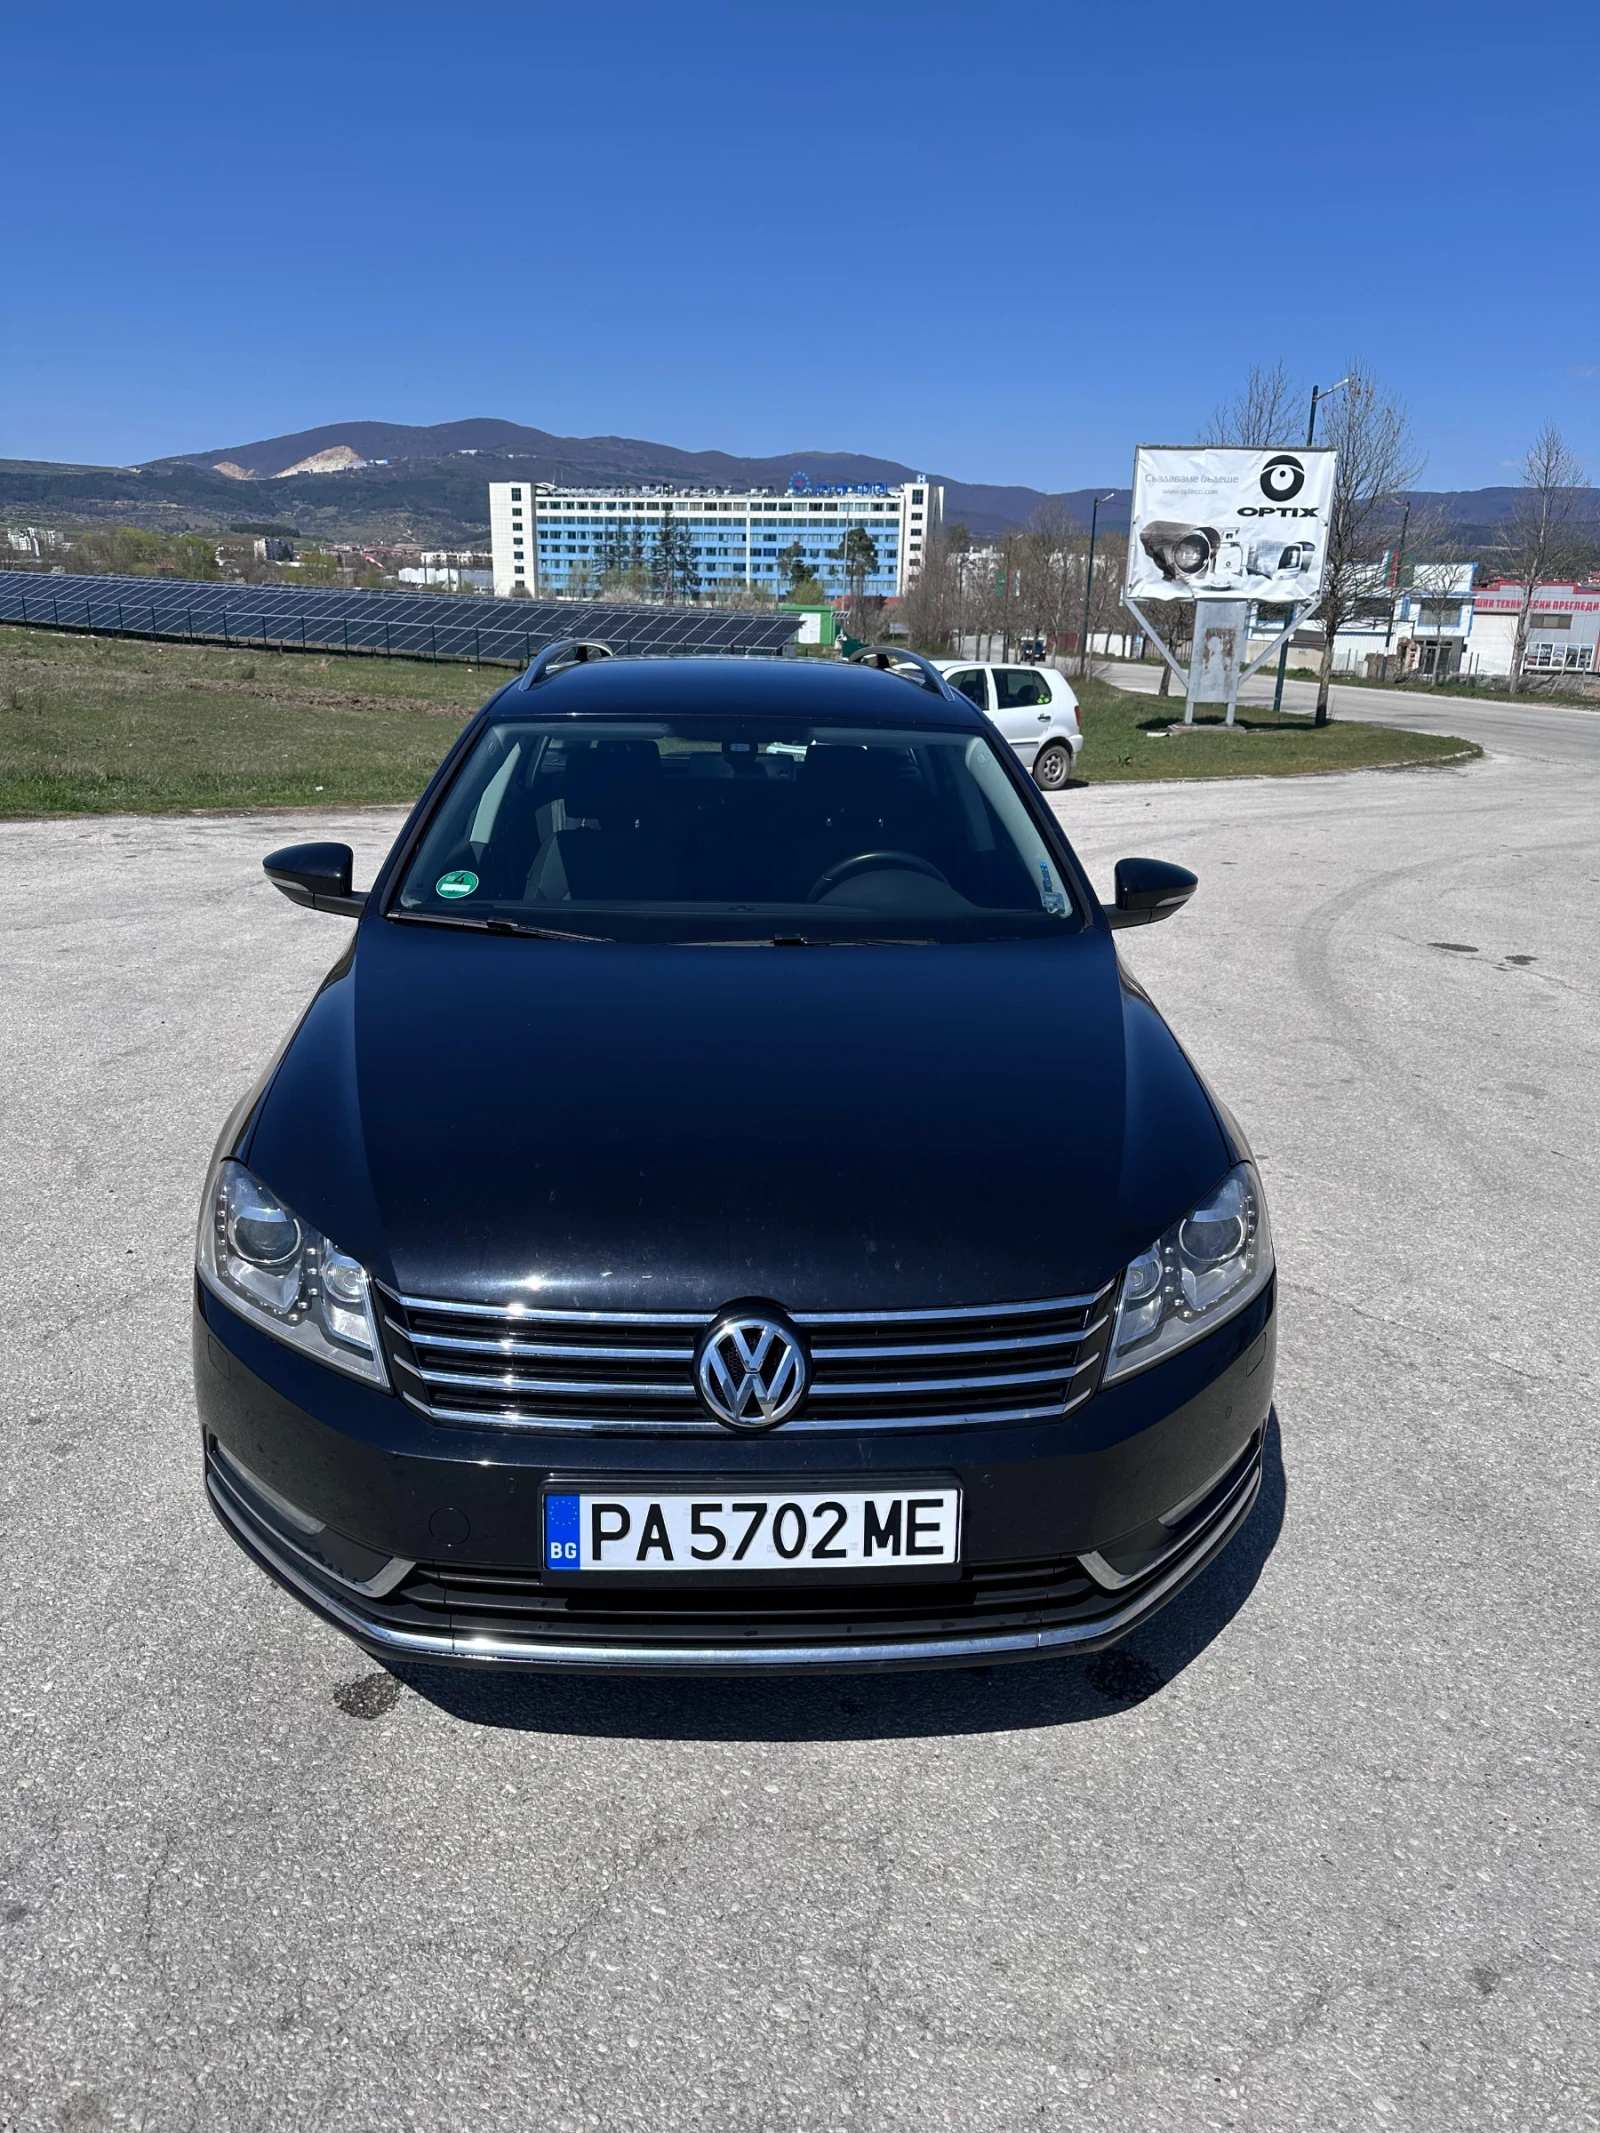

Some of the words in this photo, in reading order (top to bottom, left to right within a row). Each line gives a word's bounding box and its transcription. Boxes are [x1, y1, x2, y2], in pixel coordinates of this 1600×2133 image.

[1145, 473, 1199, 483] Създаваме
[1236, 507, 1320, 518] OPTIX
[1475, 599, 1494, 608] ШНИ
[1496, 599, 1551, 610] ТЕХНИЕСКИ
[1553, 600, 1600, 612] ПРЕГЛЕДИ
[453, 872, 465, 884] 4
[591, 1502, 675, 1561] PA
[690, 1501, 848, 1560] 5702
[863, 1498, 944, 1557] ME
[550, 1541, 577, 1559] BG
